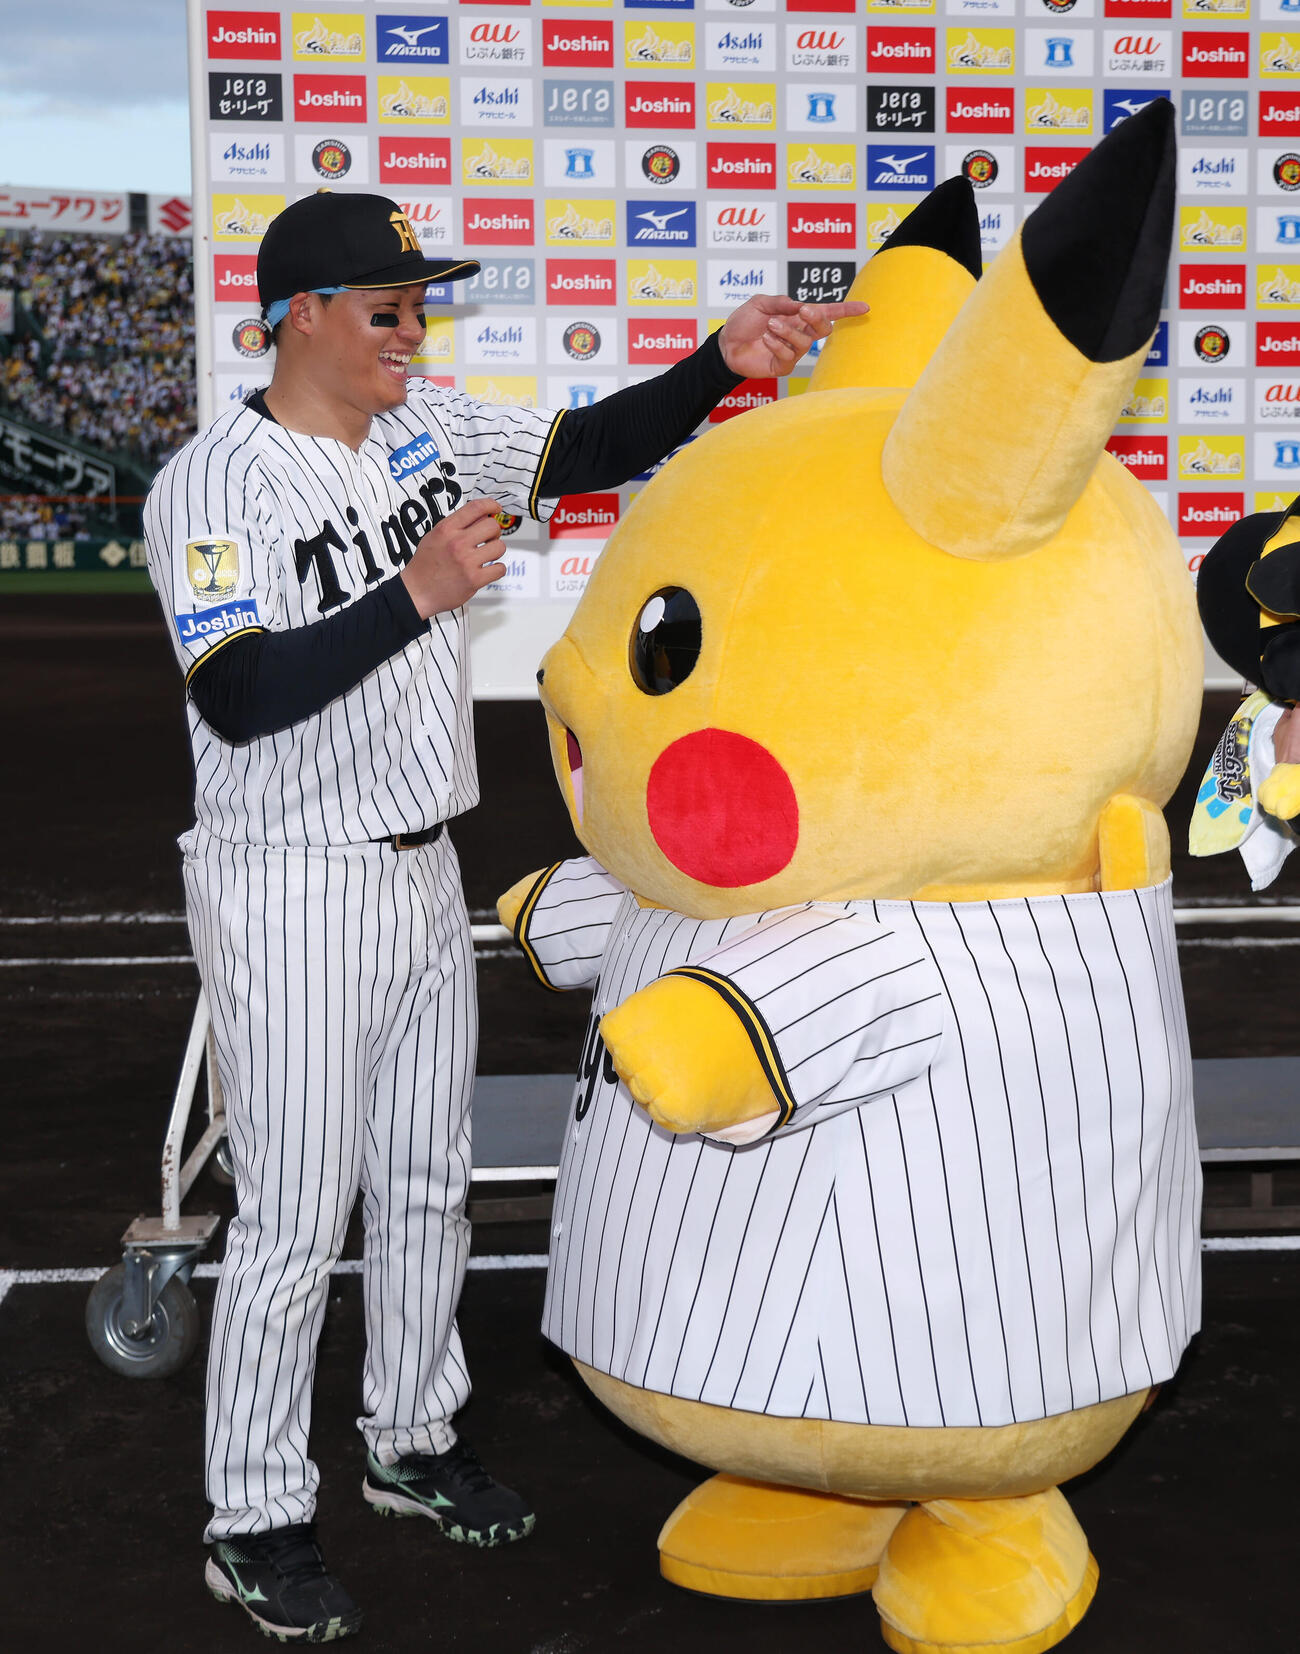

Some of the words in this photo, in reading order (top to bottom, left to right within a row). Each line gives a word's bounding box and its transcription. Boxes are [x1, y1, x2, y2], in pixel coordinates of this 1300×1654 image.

[212, 27, 277, 44] Joshin
[470, 23, 520, 43] au
[718, 32, 762, 50] Asahi
[797, 30, 845, 50] au
[548, 35, 610, 52] Joshin
[871, 42, 932, 58] Joshin
[1114, 36, 1161, 55] au
[466, 47, 525, 60] じぶん銀行
[792, 54, 849, 67] じぶん銀行
[1186, 47, 1245, 62] Joshin
[1109, 59, 1165, 71] じぶん銀行
[299, 90, 363, 107] Joshin
[473, 87, 519, 105] Asahi
[630, 97, 691, 113] Joshin
[950, 103, 1010, 119] Joshin
[224, 143, 270, 161] Asahi
[384, 153, 447, 169] Joshin
[712, 158, 772, 174] Joshin
[1192, 158, 1235, 174] Asahi
[228, 166, 267, 175] アサヒビール
[468, 214, 530, 230] Joshin
[717, 207, 765, 226] au
[980, 213, 1001, 229] ahi
[792, 218, 852, 234] Joshin
[713, 231, 770, 243] じぶん銀行
[551, 274, 612, 290] Joshin
[720, 270, 764, 287] Asahi
[1184, 279, 1242, 294] Joshin
[477, 326, 522, 344] Asahi
[633, 334, 693, 350] Joshin
[1190, 388, 1232, 404] Asahi
[554, 509, 615, 525] Joshin
[1182, 507, 1241, 522] Joshin
[295, 461, 462, 613] Tigers
[182, 608, 258, 637] Joshin
[1218, 721, 1244, 802] Tigers
